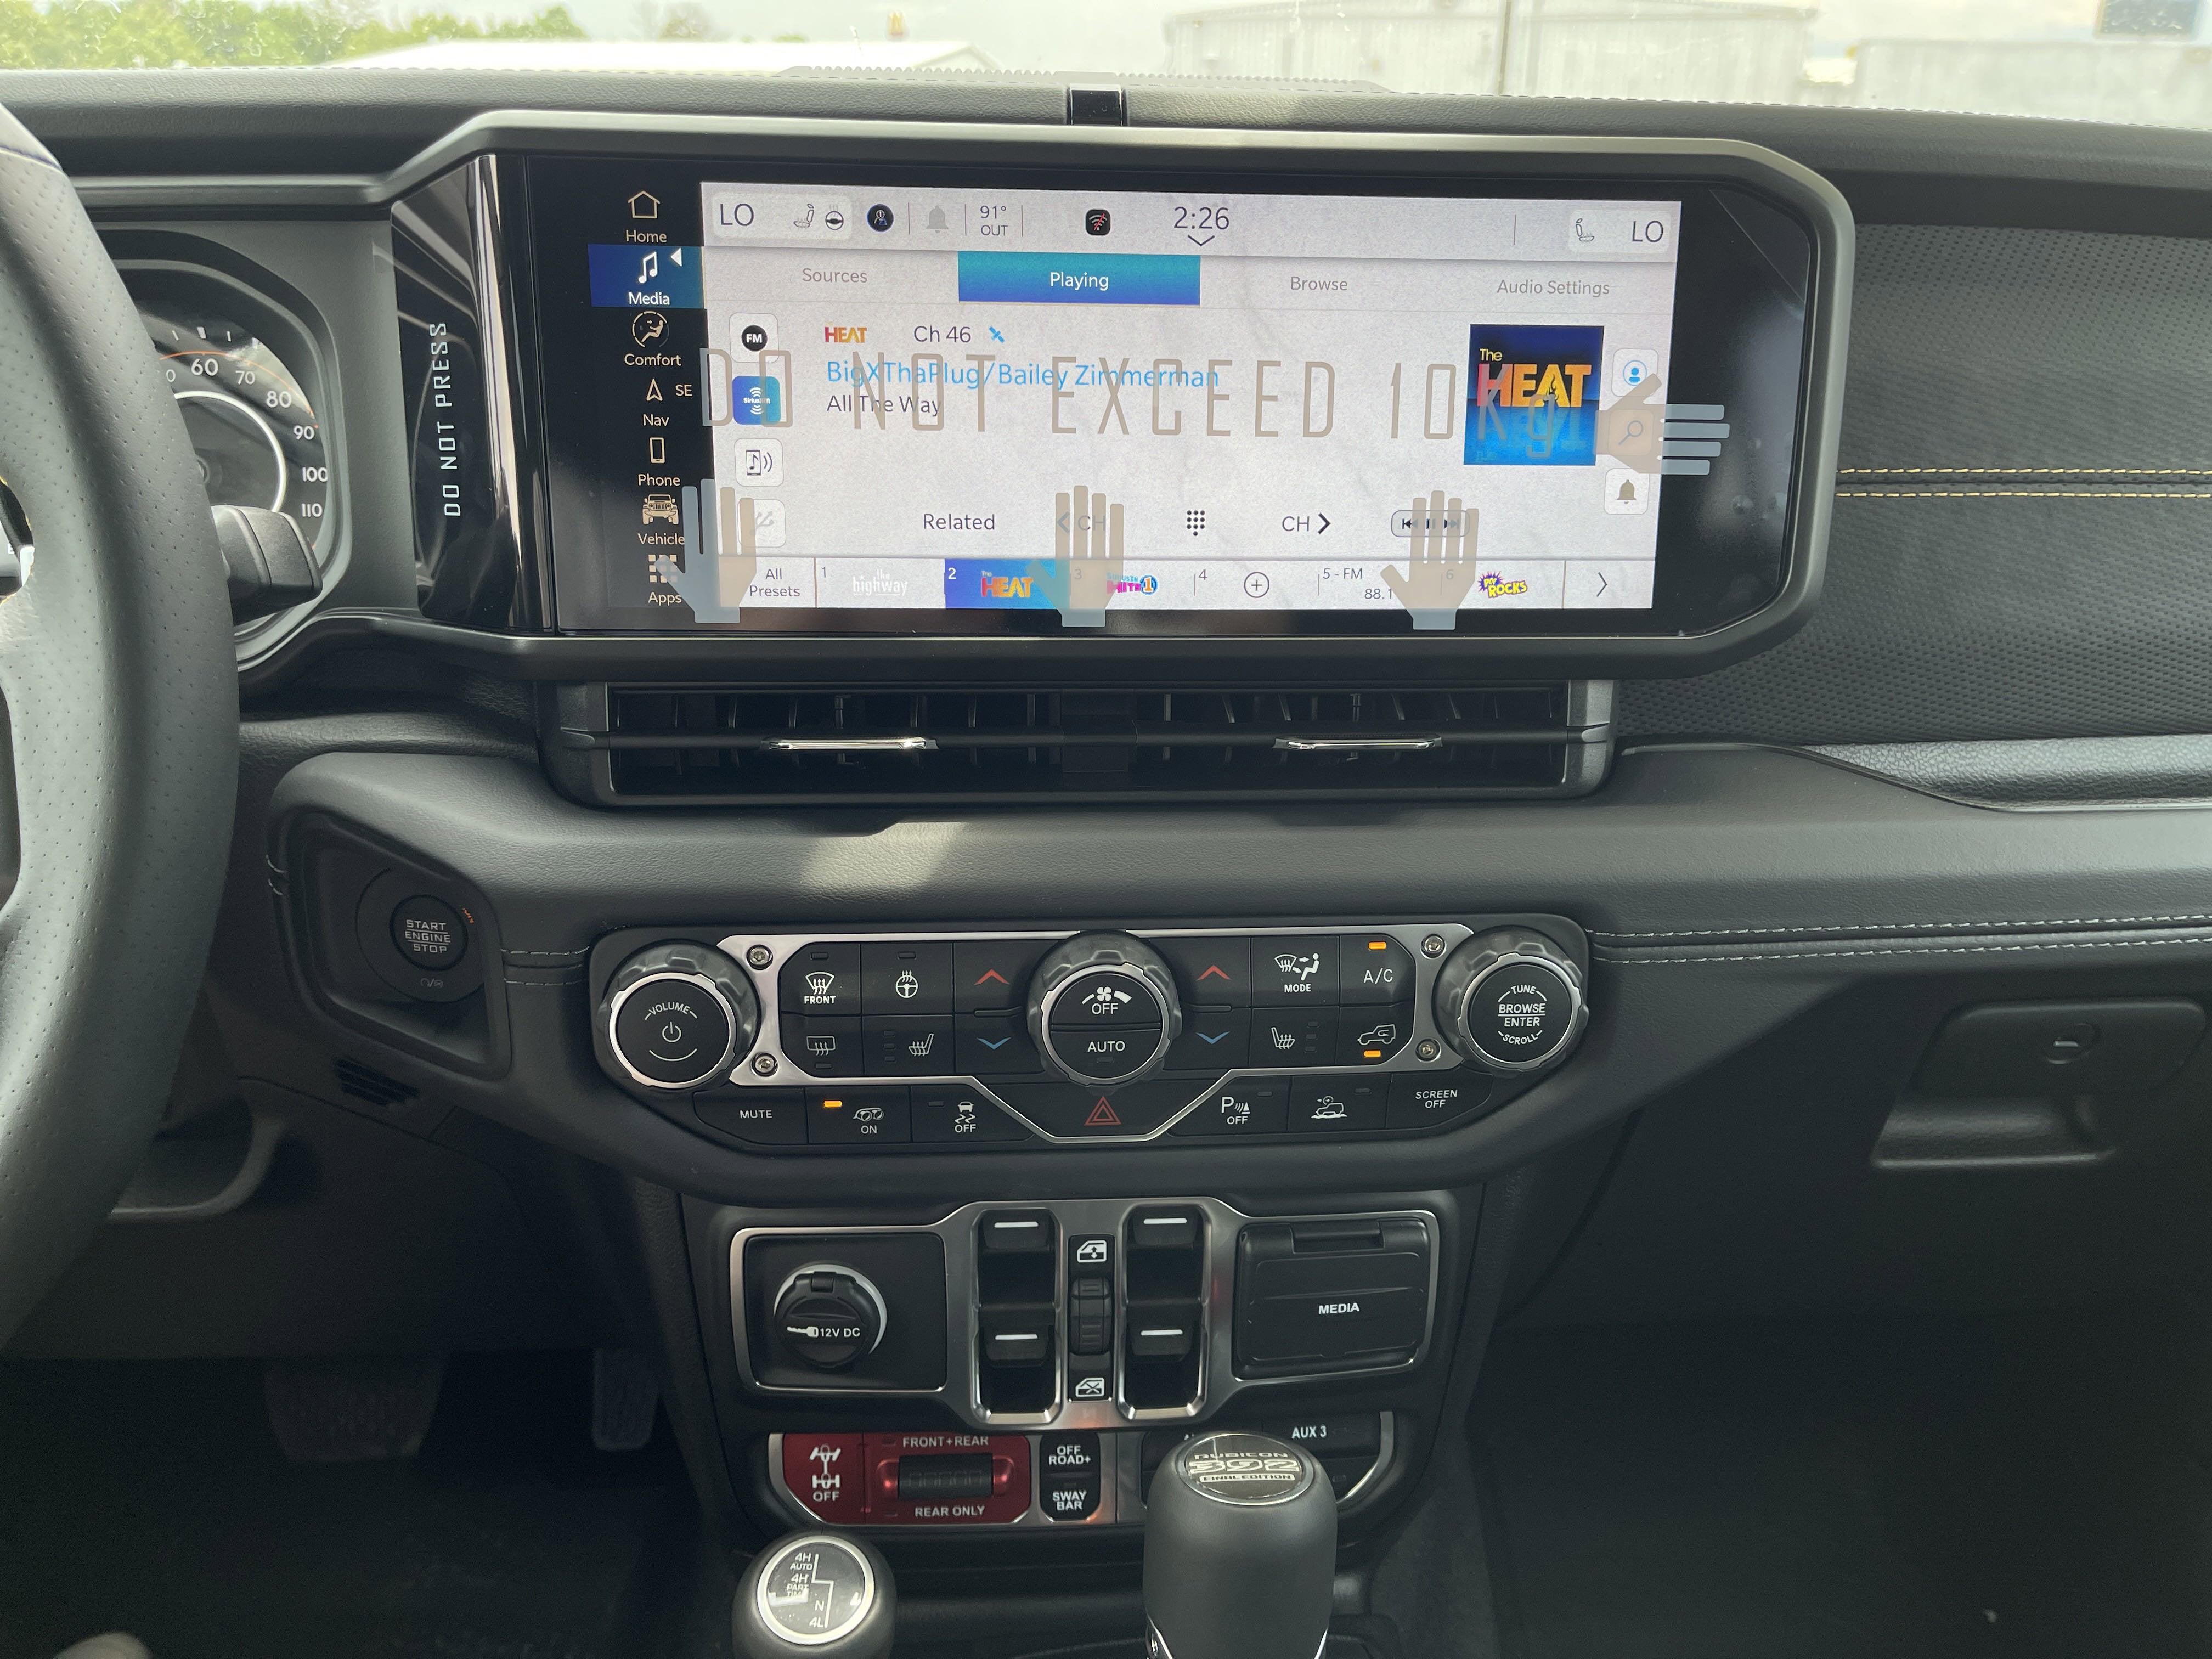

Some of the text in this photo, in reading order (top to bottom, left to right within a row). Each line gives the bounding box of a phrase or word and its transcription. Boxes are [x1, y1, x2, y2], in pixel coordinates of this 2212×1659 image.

[720, 203, 754, 226] LO
[980, 205, 1007, 219] 91°
[1173, 206, 1230, 230] 2:26
[625, 230, 667, 243] Home
[981, 225, 1008, 236] OUT
[1632, 219, 1664, 244] LO
[802, 268, 867, 283] Sources
[1050, 272, 1109, 291] Playing
[1290, 275, 1348, 292] Browse
[1497, 279, 1610, 298] Audio Settings
[629, 292, 670, 306] Media
[746, 334, 763, 343] FM
[825, 327, 867, 343] HEAT
[913, 326, 971, 343] Ch 46
[624, 353, 682, 366] Comfort
[1480, 348, 1503, 362] The
[191, 358, 219, 376] 60
[166, 369, 176, 383] 0
[235, 370, 256, 385] 70
[1075, 364, 1220, 387] Zimmerman
[675, 384, 693, 396] SE
[1477, 363, 1592, 408] HEAT
[266, 391, 292, 408] 80
[700, 348, 793, 427] DO
[853, 351, 996, 432] NOT
[1052, 356, 1336, 438] EXCEED
[1390, 363, 1457, 439] 10
[827, 394, 941, 417] All The Way
[429, 323, 461, 517] DO NOT PRESS
[642, 415, 669, 427] Nav
[293, 425, 315, 440] 90
[302, 466, 328, 482] 100
[637, 474, 681, 487] Phone
[301, 503, 323, 518] 110
[923, 513, 996, 531] Related
[1077, 515, 1107, 531] CH
[1282, 516, 1310, 532] CH
[637, 533, 686, 545] Vehicle
[765, 568, 783, 580] All
[822, 567, 826, 578] 1
[947, 568, 957, 580] 2
[1074, 569, 1082, 580] 3
[1198, 569, 1207, 580] 4
[1323, 568, 1330, 580] 5
[1344, 568, 1363, 580] FM
[1446, 569, 1454, 580] 6
[853, 575, 908, 596] highway
[980, 577, 1034, 597] HEAT
[1483, 577, 1497, 588] POP
[749, 585, 800, 598] Presets
[1364, 588, 1392, 600] 88.1
[1488, 580, 1528, 598] ROCKS
[648, 591, 682, 606] Apps
[406, 919, 446, 931] START
[405, 931, 451, 943] ENGINE
[413, 943, 447, 953] STOP
[1363, 968, 1393, 985] A/C
[1284, 983, 1312, 993] MODE
[1510, 984, 1537, 995] TUNE
[804, 995, 836, 1005] FRONT
[648, 1001, 691, 1016] VOLUME
[1091, 1003, 1119, 1015] OFF
[1498, 1003, 1545, 1014] BROWSE
[1504, 1017, 1541, 1027] ENTER
[1502, 1034, 1538, 1045] SCROLL
[1087, 1040, 1126, 1052] AUTO
[1415, 1088, 1458, 1100] SCREEN
[1424, 1098, 1447, 1109] OFF
[740, 1110, 773, 1120] MUTE
[1226, 1115, 1249, 1125] OFF
[860, 1125, 878, 1135] ON
[954, 1124, 977, 1133] OFF
[1318, 1302, 1360, 1315] MEDIA
[820, 1328, 860, 1337] 12V DC
[1291, 1425, 1327, 1440] AUX 3
[1057, 1444, 1081, 1456] OFF
[1048, 1454, 1092, 1466] ROAD+
[1189, 1459, 1300, 1474] 392
[812, 1490, 840, 1502] OFF
[1052, 1491, 1087, 1503] SWAY
[914, 1505, 986, 1517] REAR ONLY
[1056, 1499, 1083, 1511] BAR
[794, 1552, 811, 1562] 4H
[791, 1573, 809, 1583] 4H
[814, 1600, 825, 1611] N
[809, 1616, 823, 1628] 4L
